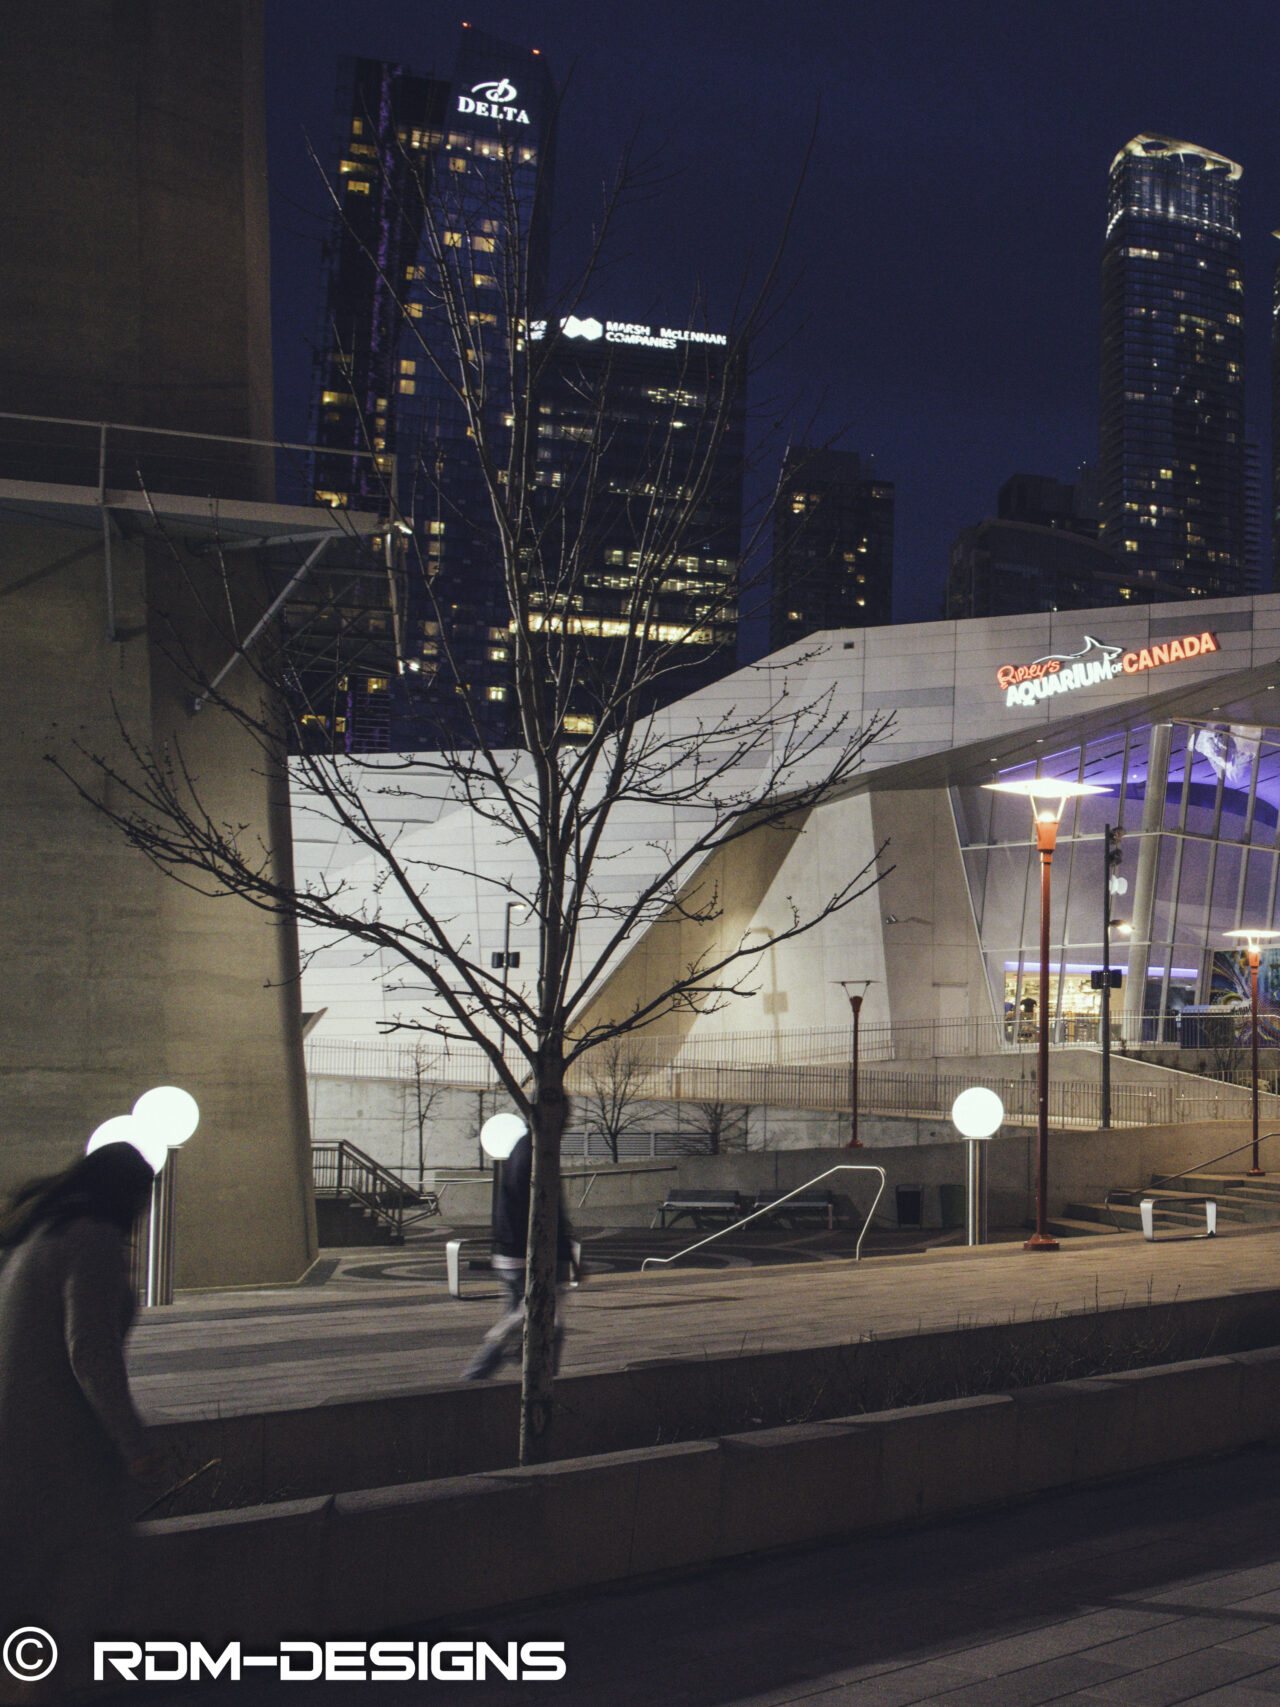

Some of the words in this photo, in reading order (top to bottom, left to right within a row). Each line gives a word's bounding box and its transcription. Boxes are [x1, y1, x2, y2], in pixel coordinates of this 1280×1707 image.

[457, 96, 530, 124] DELTA
[605, 331, 677, 350] COMPANIES
[606, 320, 650, 336] MARSH
[660, 327, 727, 346] McLENNAN
[1006, 660, 1113, 707] AQUARIUM
[1122, 632, 1217, 674] CANADA
